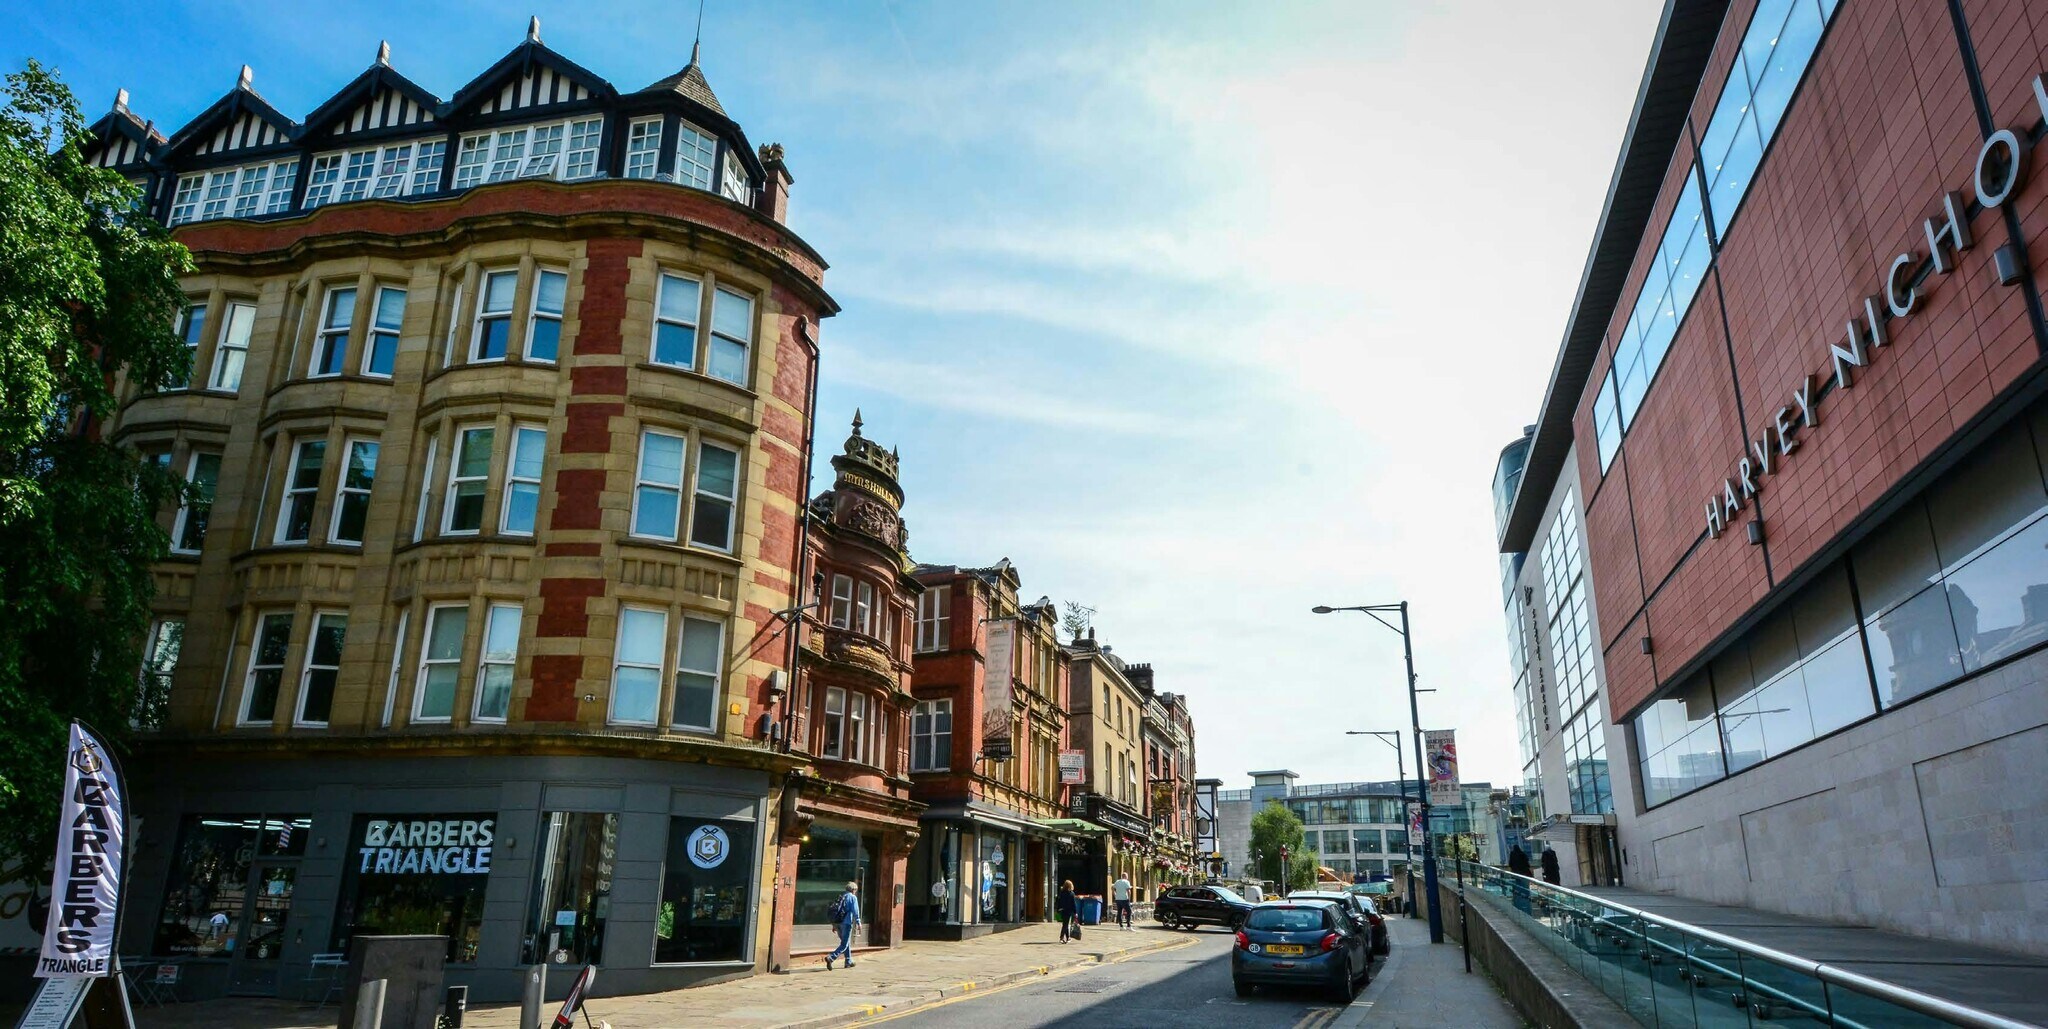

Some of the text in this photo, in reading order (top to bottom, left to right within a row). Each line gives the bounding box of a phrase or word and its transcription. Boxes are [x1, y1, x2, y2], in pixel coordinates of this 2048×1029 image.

[1705, 374, 1818, 540] HARVEY
[364, 819, 495, 847] BARBERS
[56, 777, 111, 955] BARBERS
[359, 846, 492, 875] TRIANGLE
[781, 876, 793, 889] 14
[1250, 944, 1259, 952] GB
[41, 957, 105, 974] TRIANGLE
